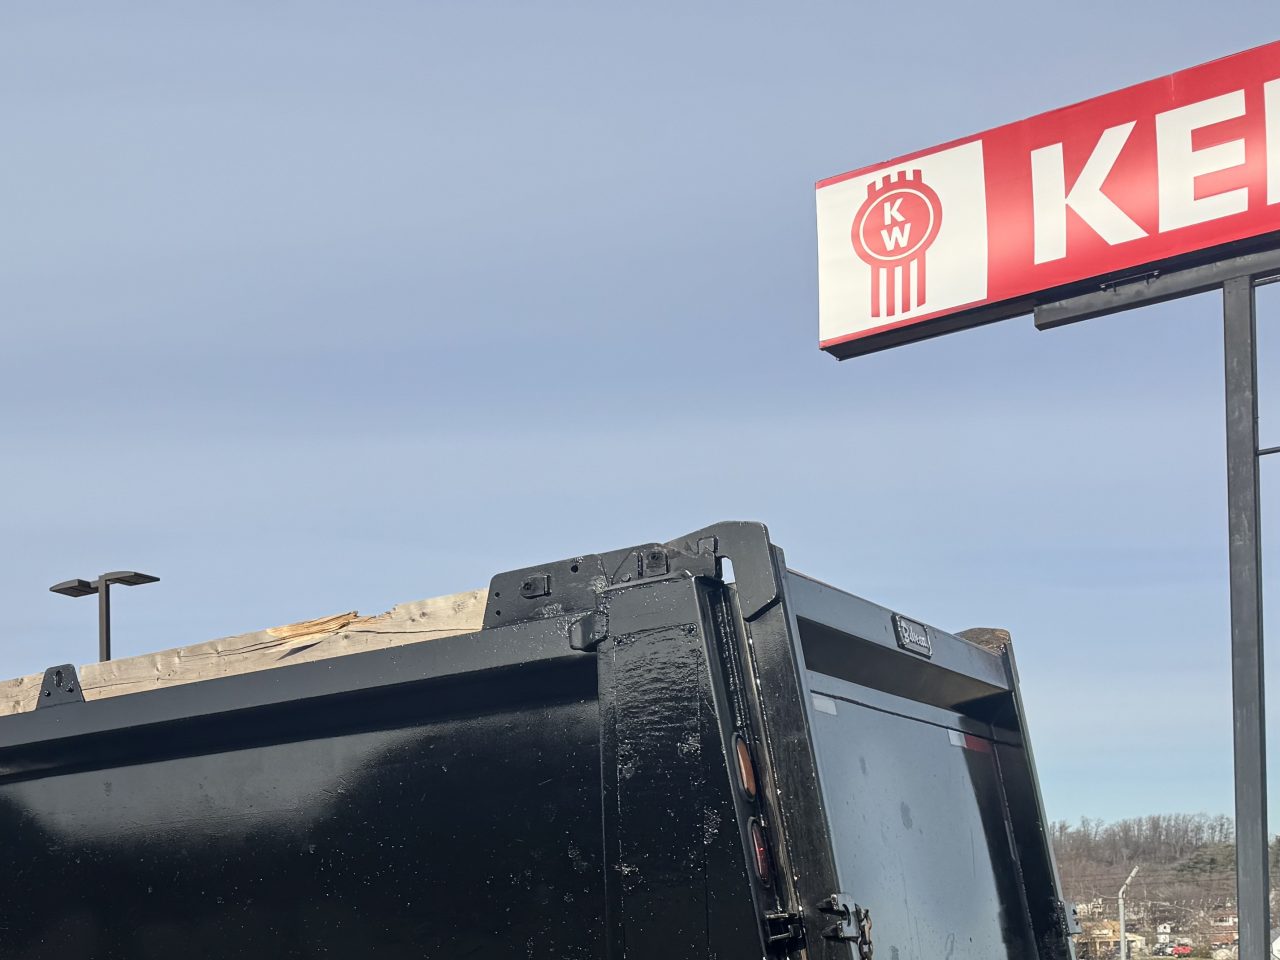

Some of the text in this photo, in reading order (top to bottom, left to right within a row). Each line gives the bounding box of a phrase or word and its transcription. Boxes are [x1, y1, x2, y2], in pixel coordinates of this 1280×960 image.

[1030, 77, 1280, 266] KE
[883, 197, 906, 226] K
[880, 223, 911, 252] W
